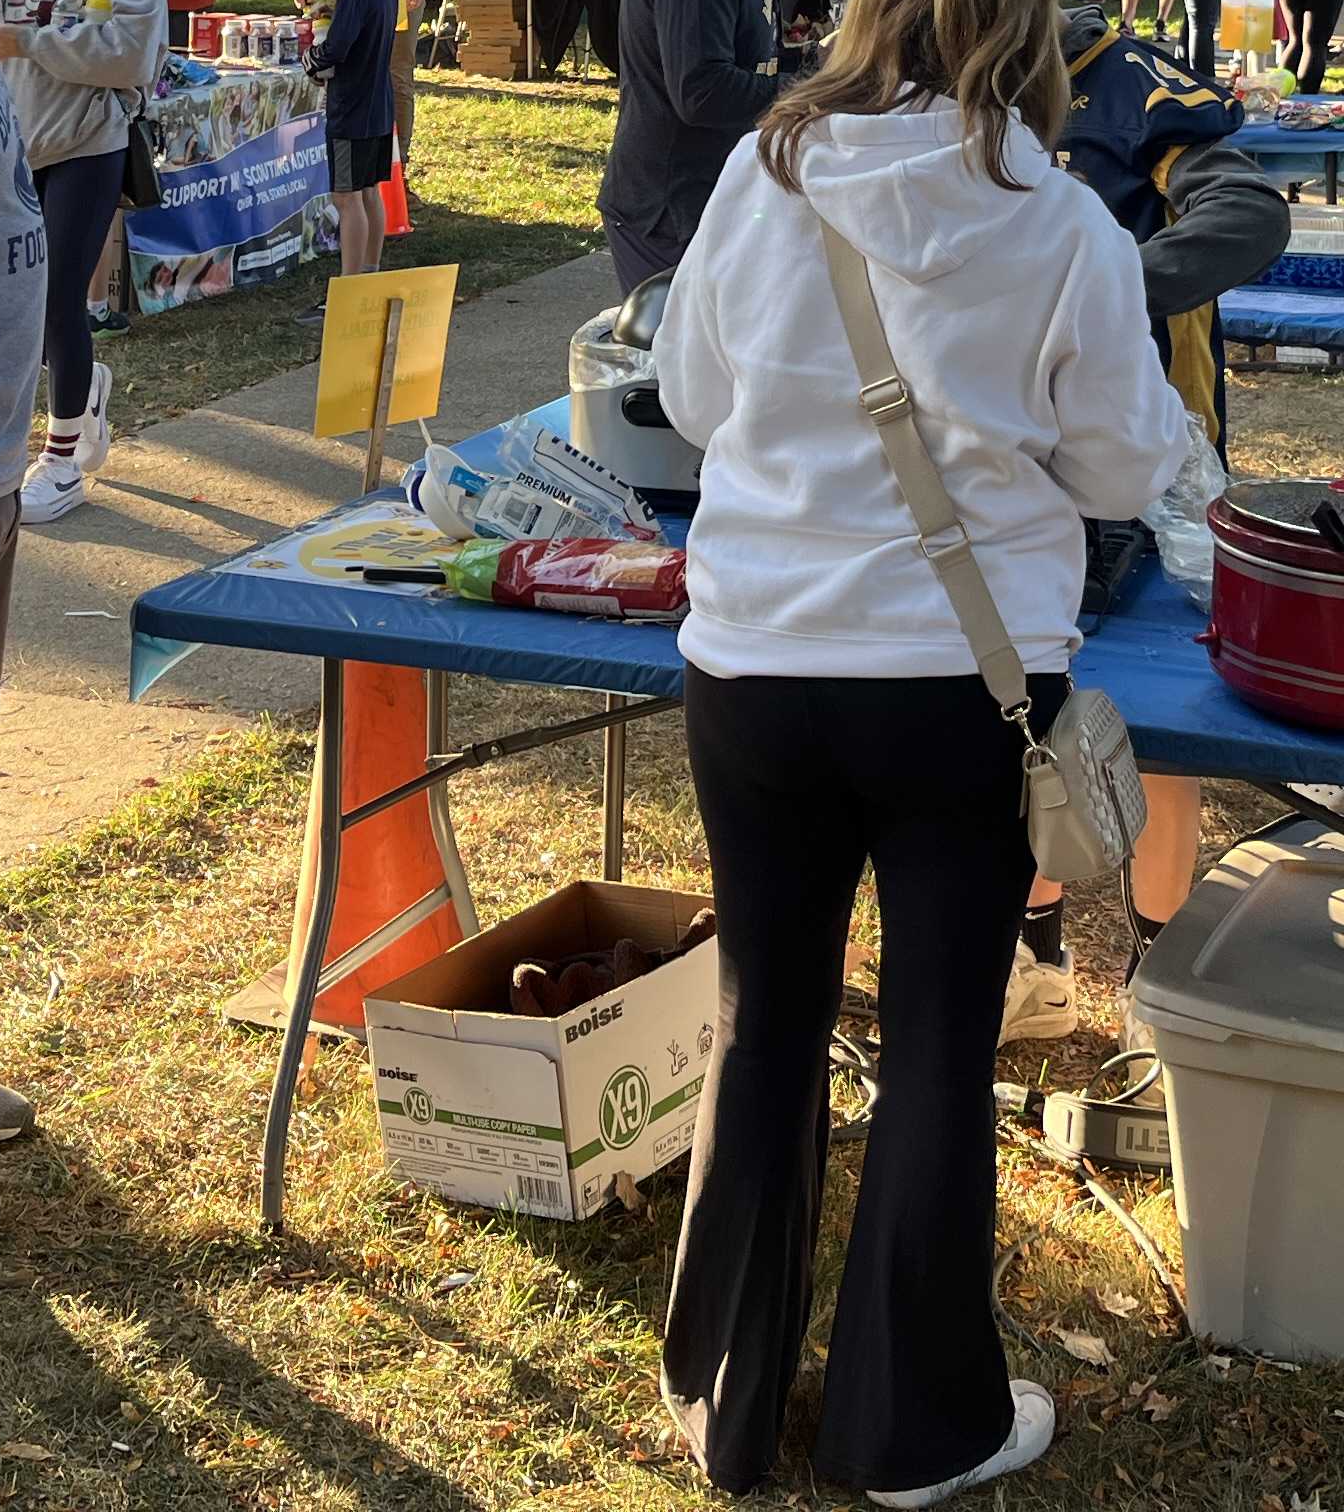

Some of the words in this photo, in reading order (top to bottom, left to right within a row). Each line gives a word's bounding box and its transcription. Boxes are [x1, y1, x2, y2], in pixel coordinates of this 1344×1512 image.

[160, 175, 227, 209] SUPPORT
[243, 155, 290, 187] SCOUTING
[7, 226, 47, 275] FOO
[515, 472, 572, 506] PREMIUM
[452, 1114, 491, 1131] MULTI-USE
[491, 1119, 512, 1133] COPY
[512, 1123, 537, 1137] PAPER
[1126, 1125, 1169, 1154] ETI
